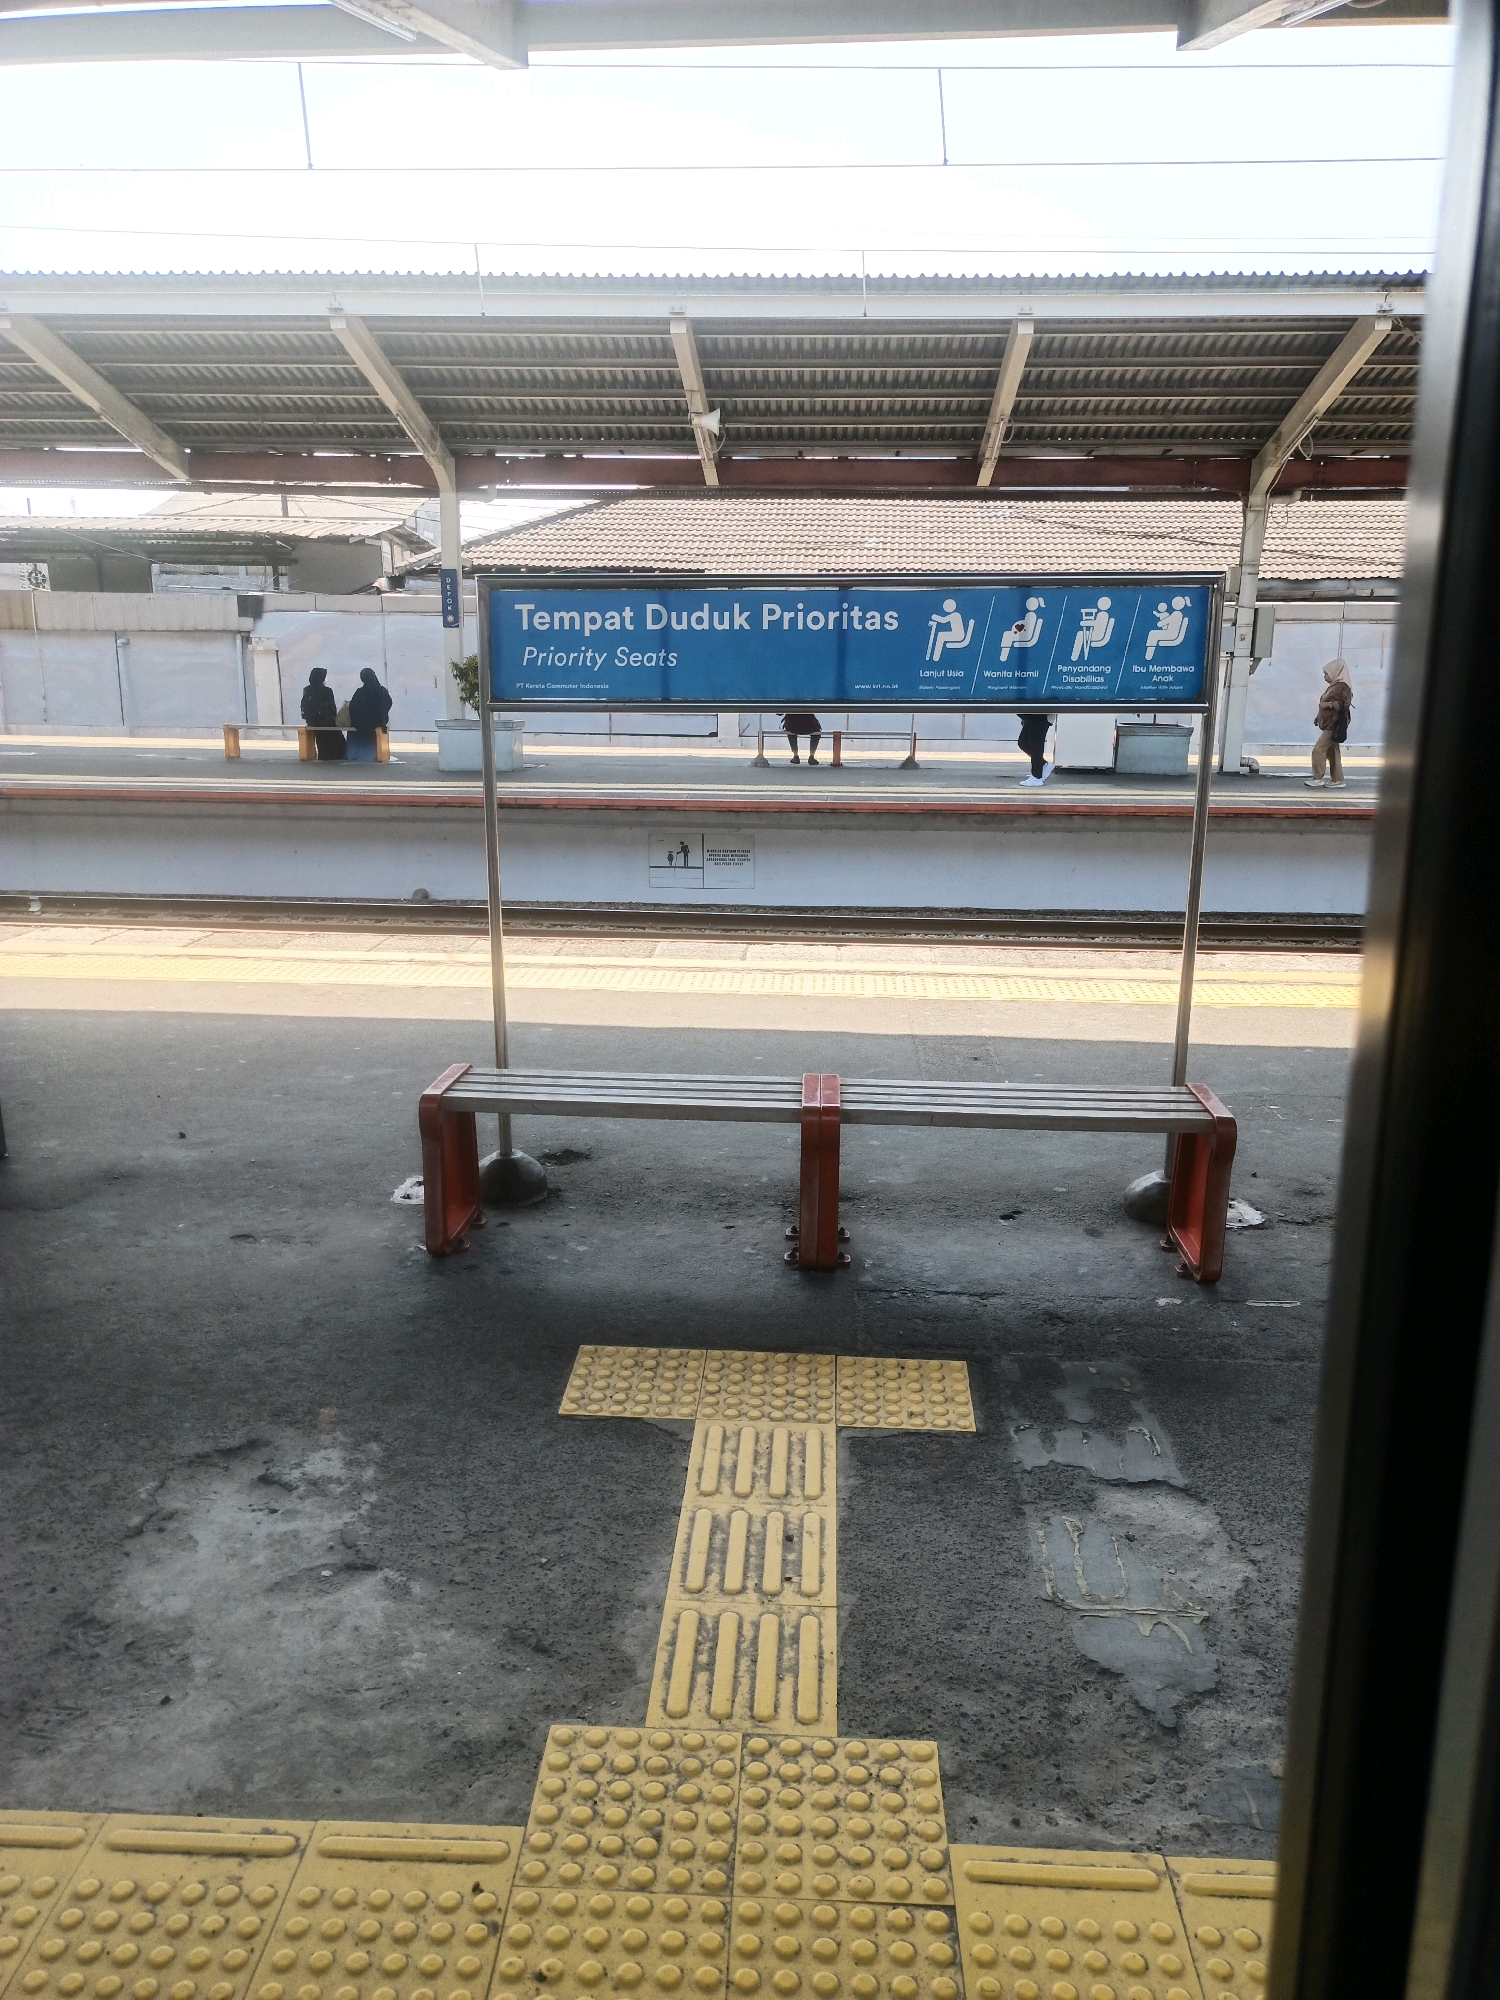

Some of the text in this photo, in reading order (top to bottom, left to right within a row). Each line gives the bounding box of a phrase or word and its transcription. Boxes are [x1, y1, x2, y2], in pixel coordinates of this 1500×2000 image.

[514, 602, 899, 637] Tempat Duduk Prioritas
[522, 646, 678, 671] Priority Seats
[920, 669, 964, 678] Lanjut Usia
[1057, 665, 1111, 674] Penyandang
[1132, 665, 1195, 673] Ibu Membawa
[983, 670, 1039, 678] Wanita Hamil
[1062, 675, 1104, 683] Disabilitas
